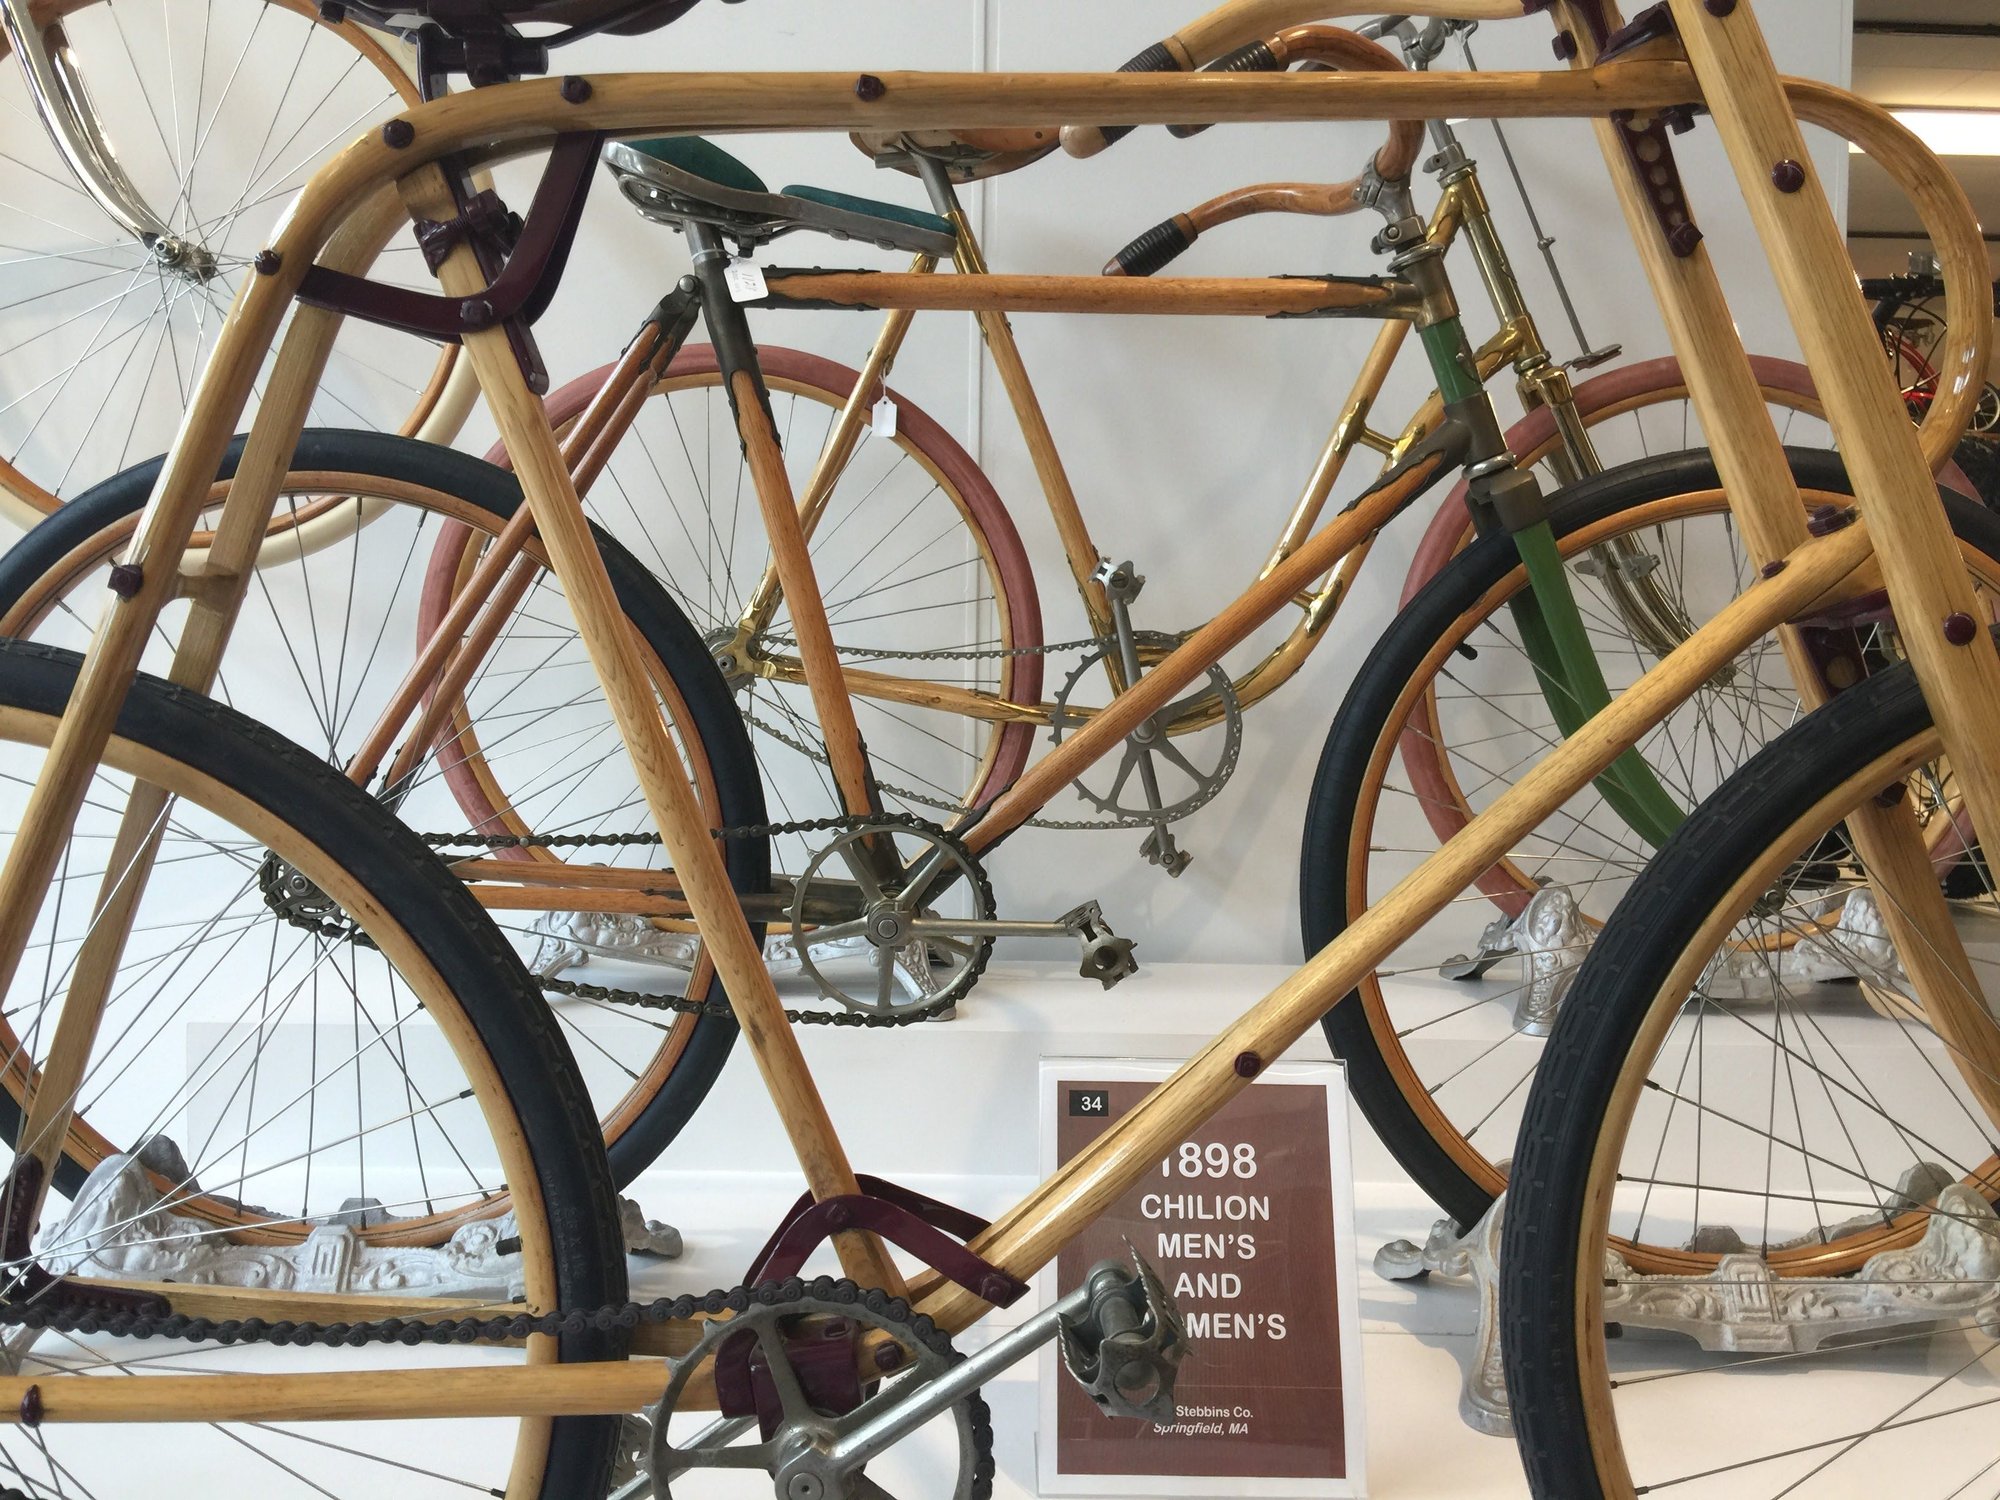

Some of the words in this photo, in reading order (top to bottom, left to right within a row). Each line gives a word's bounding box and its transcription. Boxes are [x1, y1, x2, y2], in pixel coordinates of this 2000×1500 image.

[1081, 1096, 1103, 1112] 34
[1141, 1193, 1270, 1221] CHILION
[1158, 1233, 1257, 1260] MEN'S
[1173, 1272, 1242, 1299] AND
[1186, 1312, 1287, 1340] MEN'S
[1175, 1405, 1231, 1418] Stebbins
[1233, 1406, 1254, 1418] Co.
[1153, 1422, 1225, 1436] Springfield,
[1228, 1423, 1249, 1434] MA
